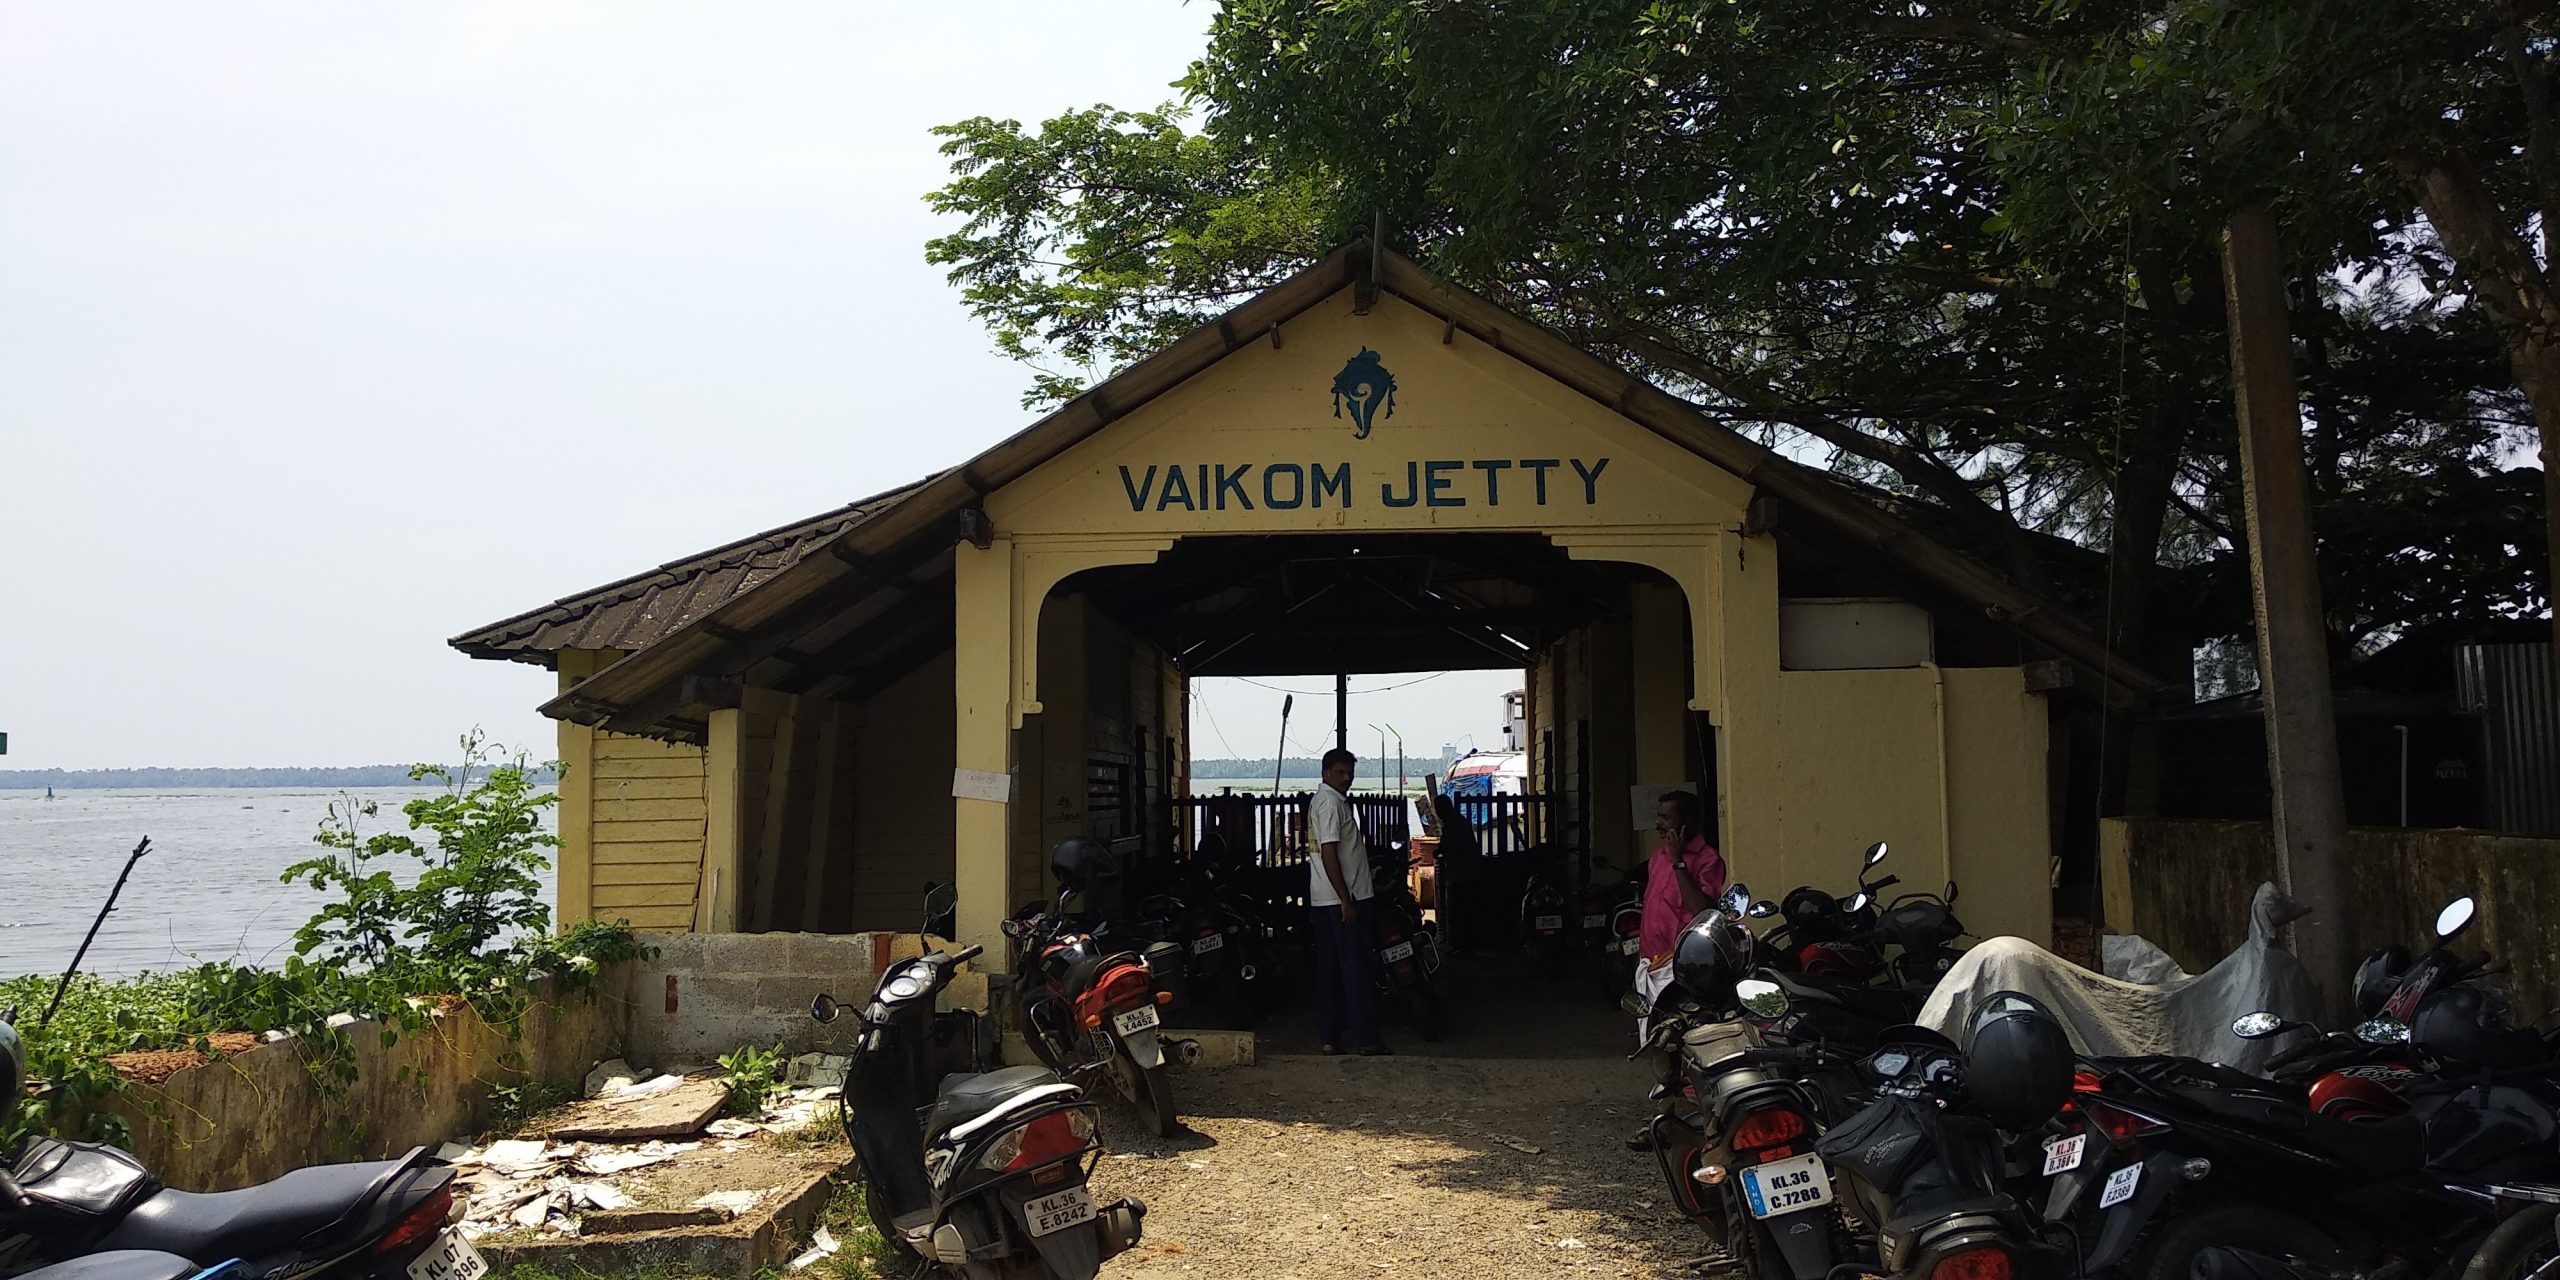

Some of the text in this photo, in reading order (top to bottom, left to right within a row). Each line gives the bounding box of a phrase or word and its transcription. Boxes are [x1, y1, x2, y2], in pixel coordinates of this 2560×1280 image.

[1118, 458, 1610, 512] VAIKOM JETTY
[1123, 1016, 1153, 1032] Y.4452
[2055, 1140, 2077, 1157] KL.36
[1770, 1170, 1811, 1190] KL.36
[1041, 1192, 1076, 1214] KL.36
[1750, 1184, 1761, 1206] IND
[1770, 1186, 1821, 1209] C.7288
[1040, 1206, 1087, 1231] E.8242
[425, 1243, 461, 1280] KL 07
[445, 1256, 479, 1280] 896
